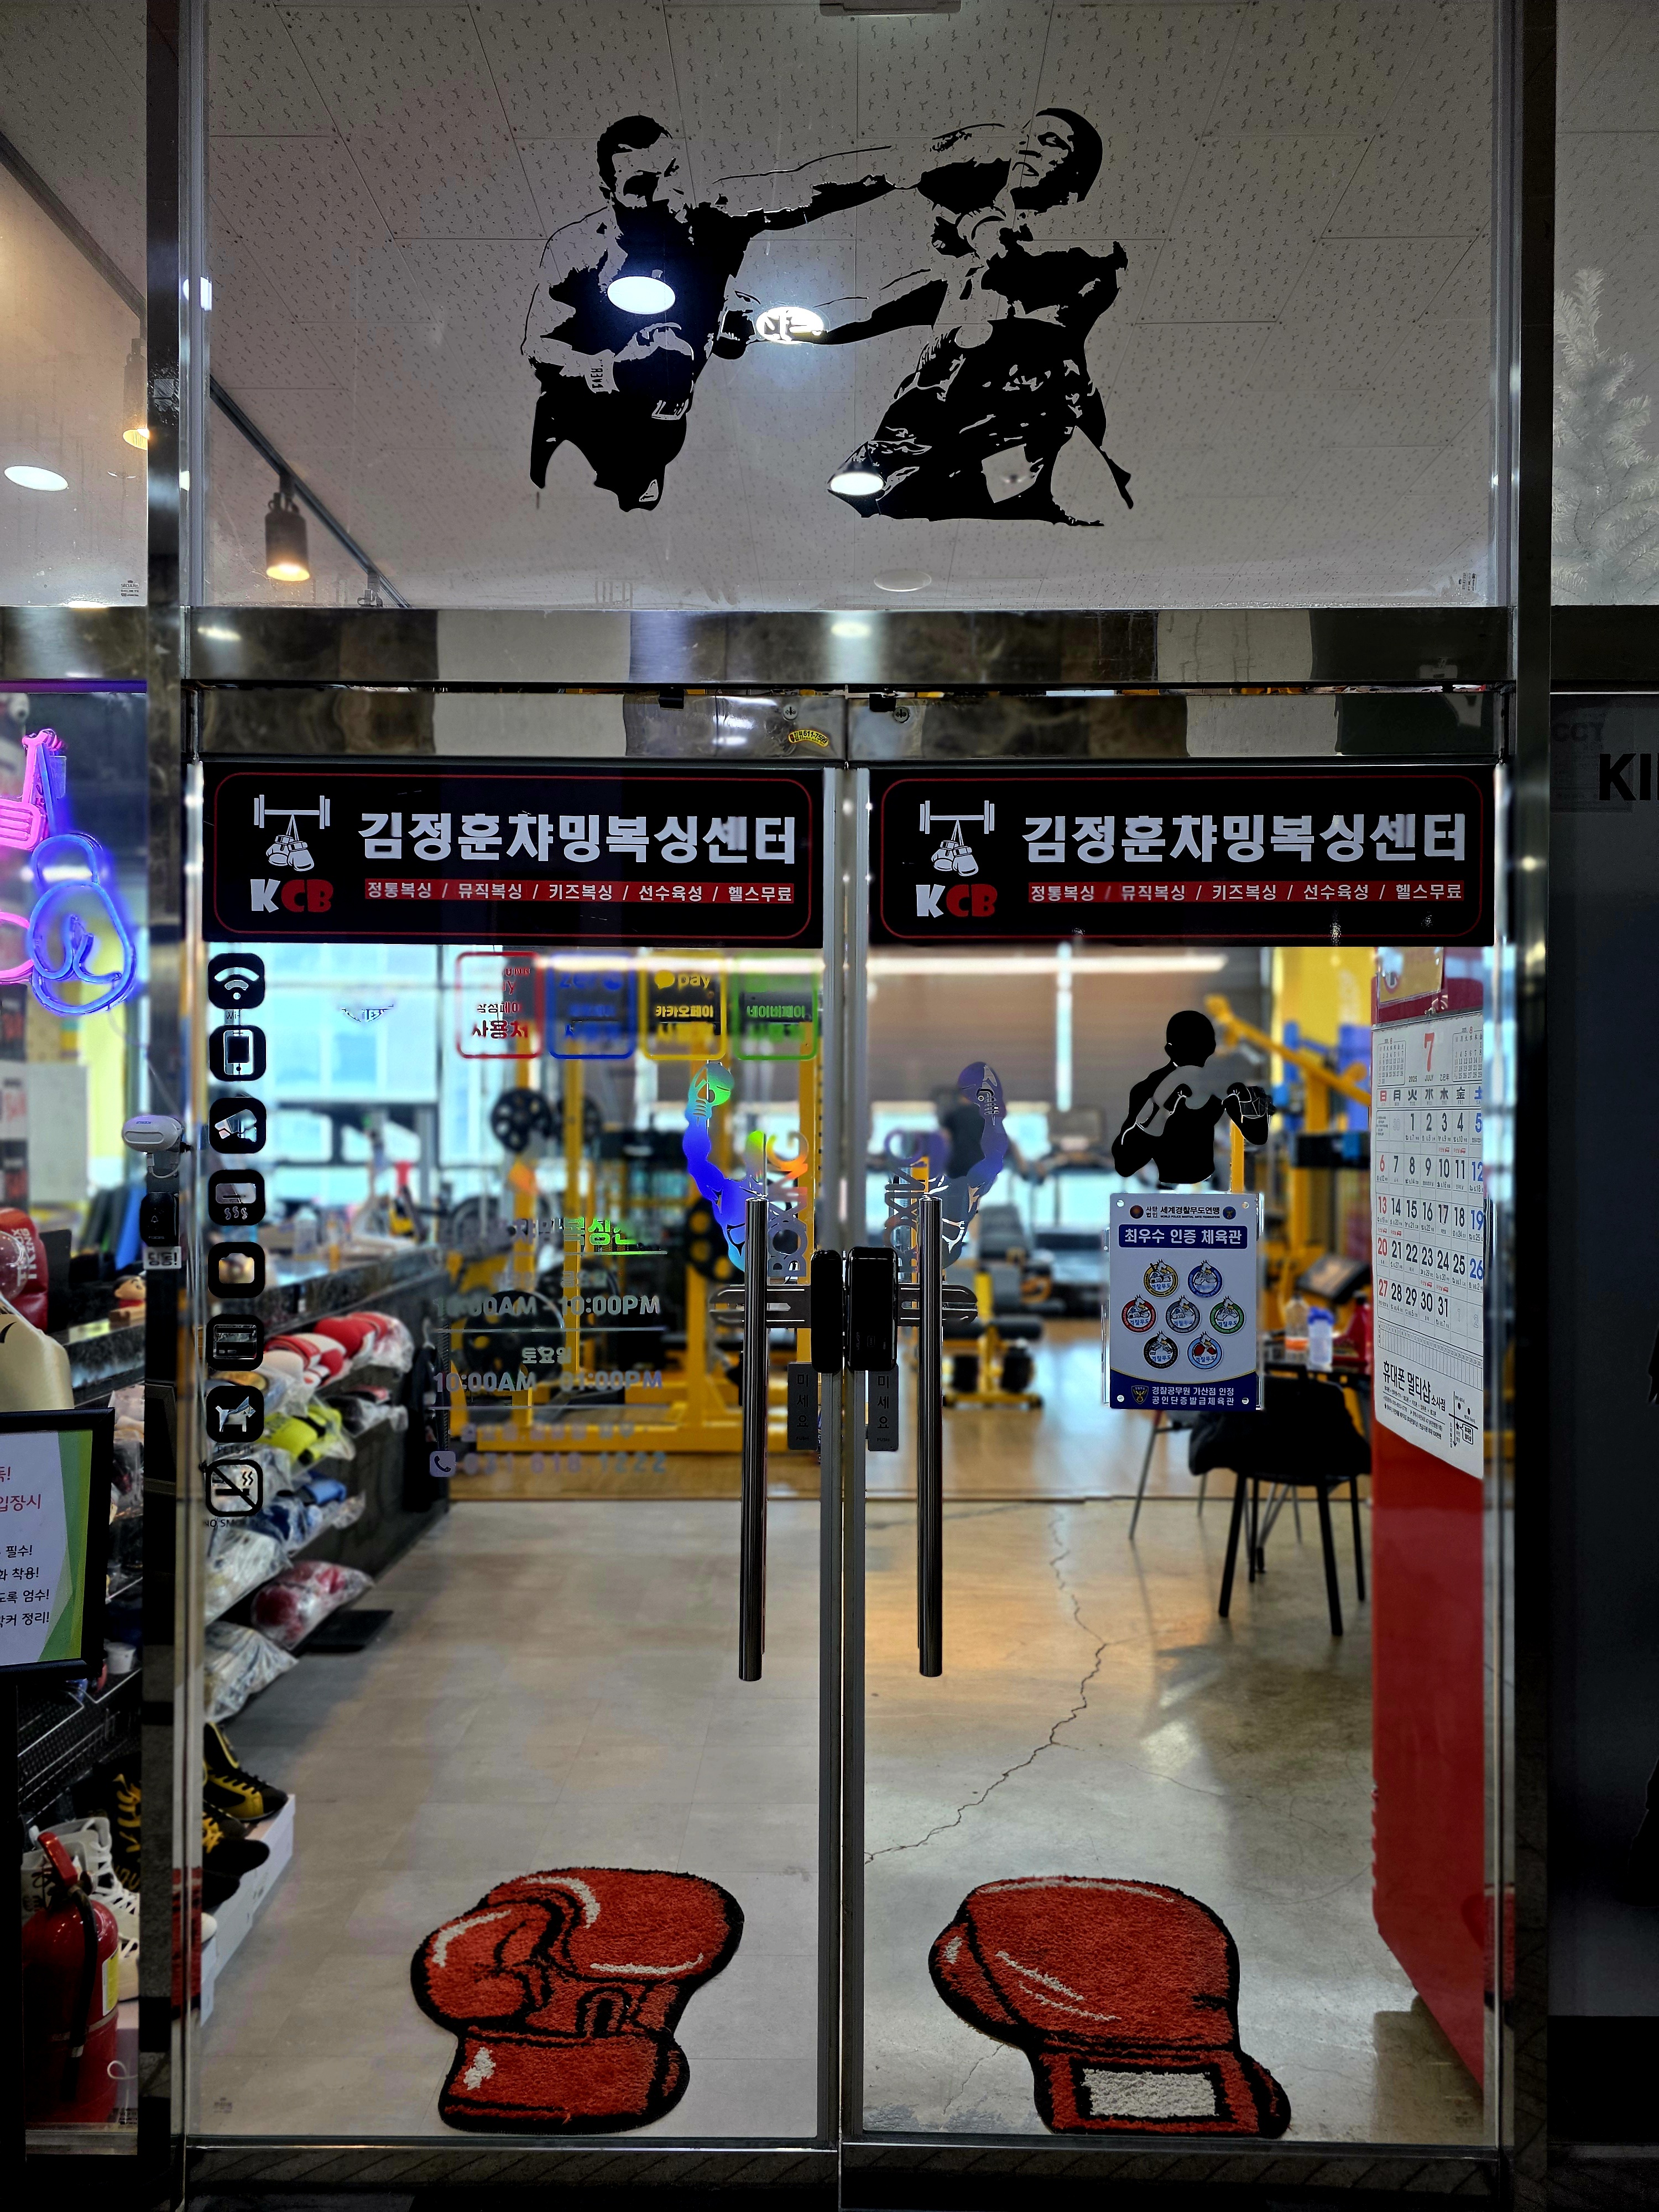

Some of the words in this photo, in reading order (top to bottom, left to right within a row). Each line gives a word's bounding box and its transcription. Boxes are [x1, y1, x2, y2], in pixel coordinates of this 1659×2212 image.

[804, 731, 827, 743] 611-7599
[1599, 753, 1659, 801] KI
[358, 812, 795, 864] 김정훈챠밍복싱센터
[1022, 813, 1465, 864] 김정훈챠밍복싱센터
[251, 878, 333, 913] KCB
[368, 881, 431, 899] 정통복싱
[458, 883, 522, 900] 뮤직복싱
[549, 885, 612, 901] 키즈복싱
[639, 886, 702, 902] 선수육성
[728, 886, 792, 902] 헬스무료
[915, 884, 998, 918] KCB
[1031, 885, 1094, 902] 정통복싱
[1121, 885, 1185, 901] 뮤직복싱
[1212, 884, 1276, 900] 키즈복싱
[1303, 884, 1369, 900] 선수육성
[1395, 884, 1462, 900] 헬스무료
[678, 973, 711, 991] pay
[655, 1005, 714, 1018] 카카오페이
[472, 1020, 529, 1039] 사용처
[1424, 1032, 1435, 1072] 7
[1380, 1090, 1387, 1102] 日
[1393, 1089, 1401, 1102] 月
[1407, 1089, 1417, 1101] 火
[1425, 1088, 1434, 1100] 水
[1439, 1087, 1449, 1100] 木
[1456, 1086, 1465, 1099] 金
[1474, 1086, 1483, 1099] 土
[1410, 1113, 1415, 1131] 1
[1426, 1113, 1432, 1131] 2
[1441, 1113, 1447, 1131] 3
[1457, 1112, 1464, 1131] 4
[1475, 1113, 1483, 1133] 5
[1380, 1154, 1385, 1172] 6
[1394, 1155, 1399, 1172] 7
[1409, 1156, 1415, 1175] 8
[1425, 1157, 1432, 1176] 9
[1439, 1159, 1449, 1178] 10
[1455, 1159, 1465, 1180] 11
[1472, 1161, 1483, 1182] 12
[768, 1131, 809, 1276] BOXING
[1160, 1206, 1220, 1215] 세계경찰무도연맹
[1378, 1196, 1387, 1214] 13
[1391, 1198, 1401, 1216] 14
[1406, 1199, 1417, 1218] 15
[1422, 1202, 1433, 1221] 16
[1438, 1204, 1448, 1224] 17
[1454, 1207, 1465, 1227] 18
[1470, 1210, 1483, 1230] 19
[1125, 1228, 1165, 1243] 최우수
[1170, 1229, 1196, 1244] 인증
[1201, 1229, 1242, 1244] 체육관
[147, 1251, 178, 1266] 딩동!
[1378, 1237, 1387, 1256] 20
[1391, 1240, 1401, 1259] 21
[1406, 1243, 1418, 1263] 22
[1421, 1246, 1433, 1267] 23
[1437, 1250, 1449, 1271] 24
[1453, 1253, 1465, 1275] 25
[1469, 1258, 1483, 1280] 26
[559, 1295, 661, 1316] 10:00PM
[1379, 1279, 1388, 1297] 27
[1391, 1282, 1402, 1302] 28
[1405, 1286, 1417, 1306] 29
[1421, 1291, 1433, 1312] 30
[1438, 1296, 1448, 1318] 31
[1473, 1314, 1479, 1328] 2
[521, 1347, 572, 1364] 토요일
[433, 1371, 537, 1392] 10:00AM
[1152, 1386, 1190, 1395] 경찰공무원
[1193, 1387, 1216, 1395] 가산점
[1219, 1387, 1234, 1396] 인정
[1383, 1360, 1405, 1391] 휴대폰
[1407, 1371, 1431, 1405] 멀티샵
[1431, 1394, 1446, 1412] 소사점
[796, 1374, 809, 1427] 미세요
[877, 1375, 890, 1429] 미세요
[6, 1545, 33, 1557] 필수!
[12, 1566, 39, 1579] 착용!
[23, 1589, 50, 1601] 엄수!
[22, 1611, 50, 1625] 정리!
